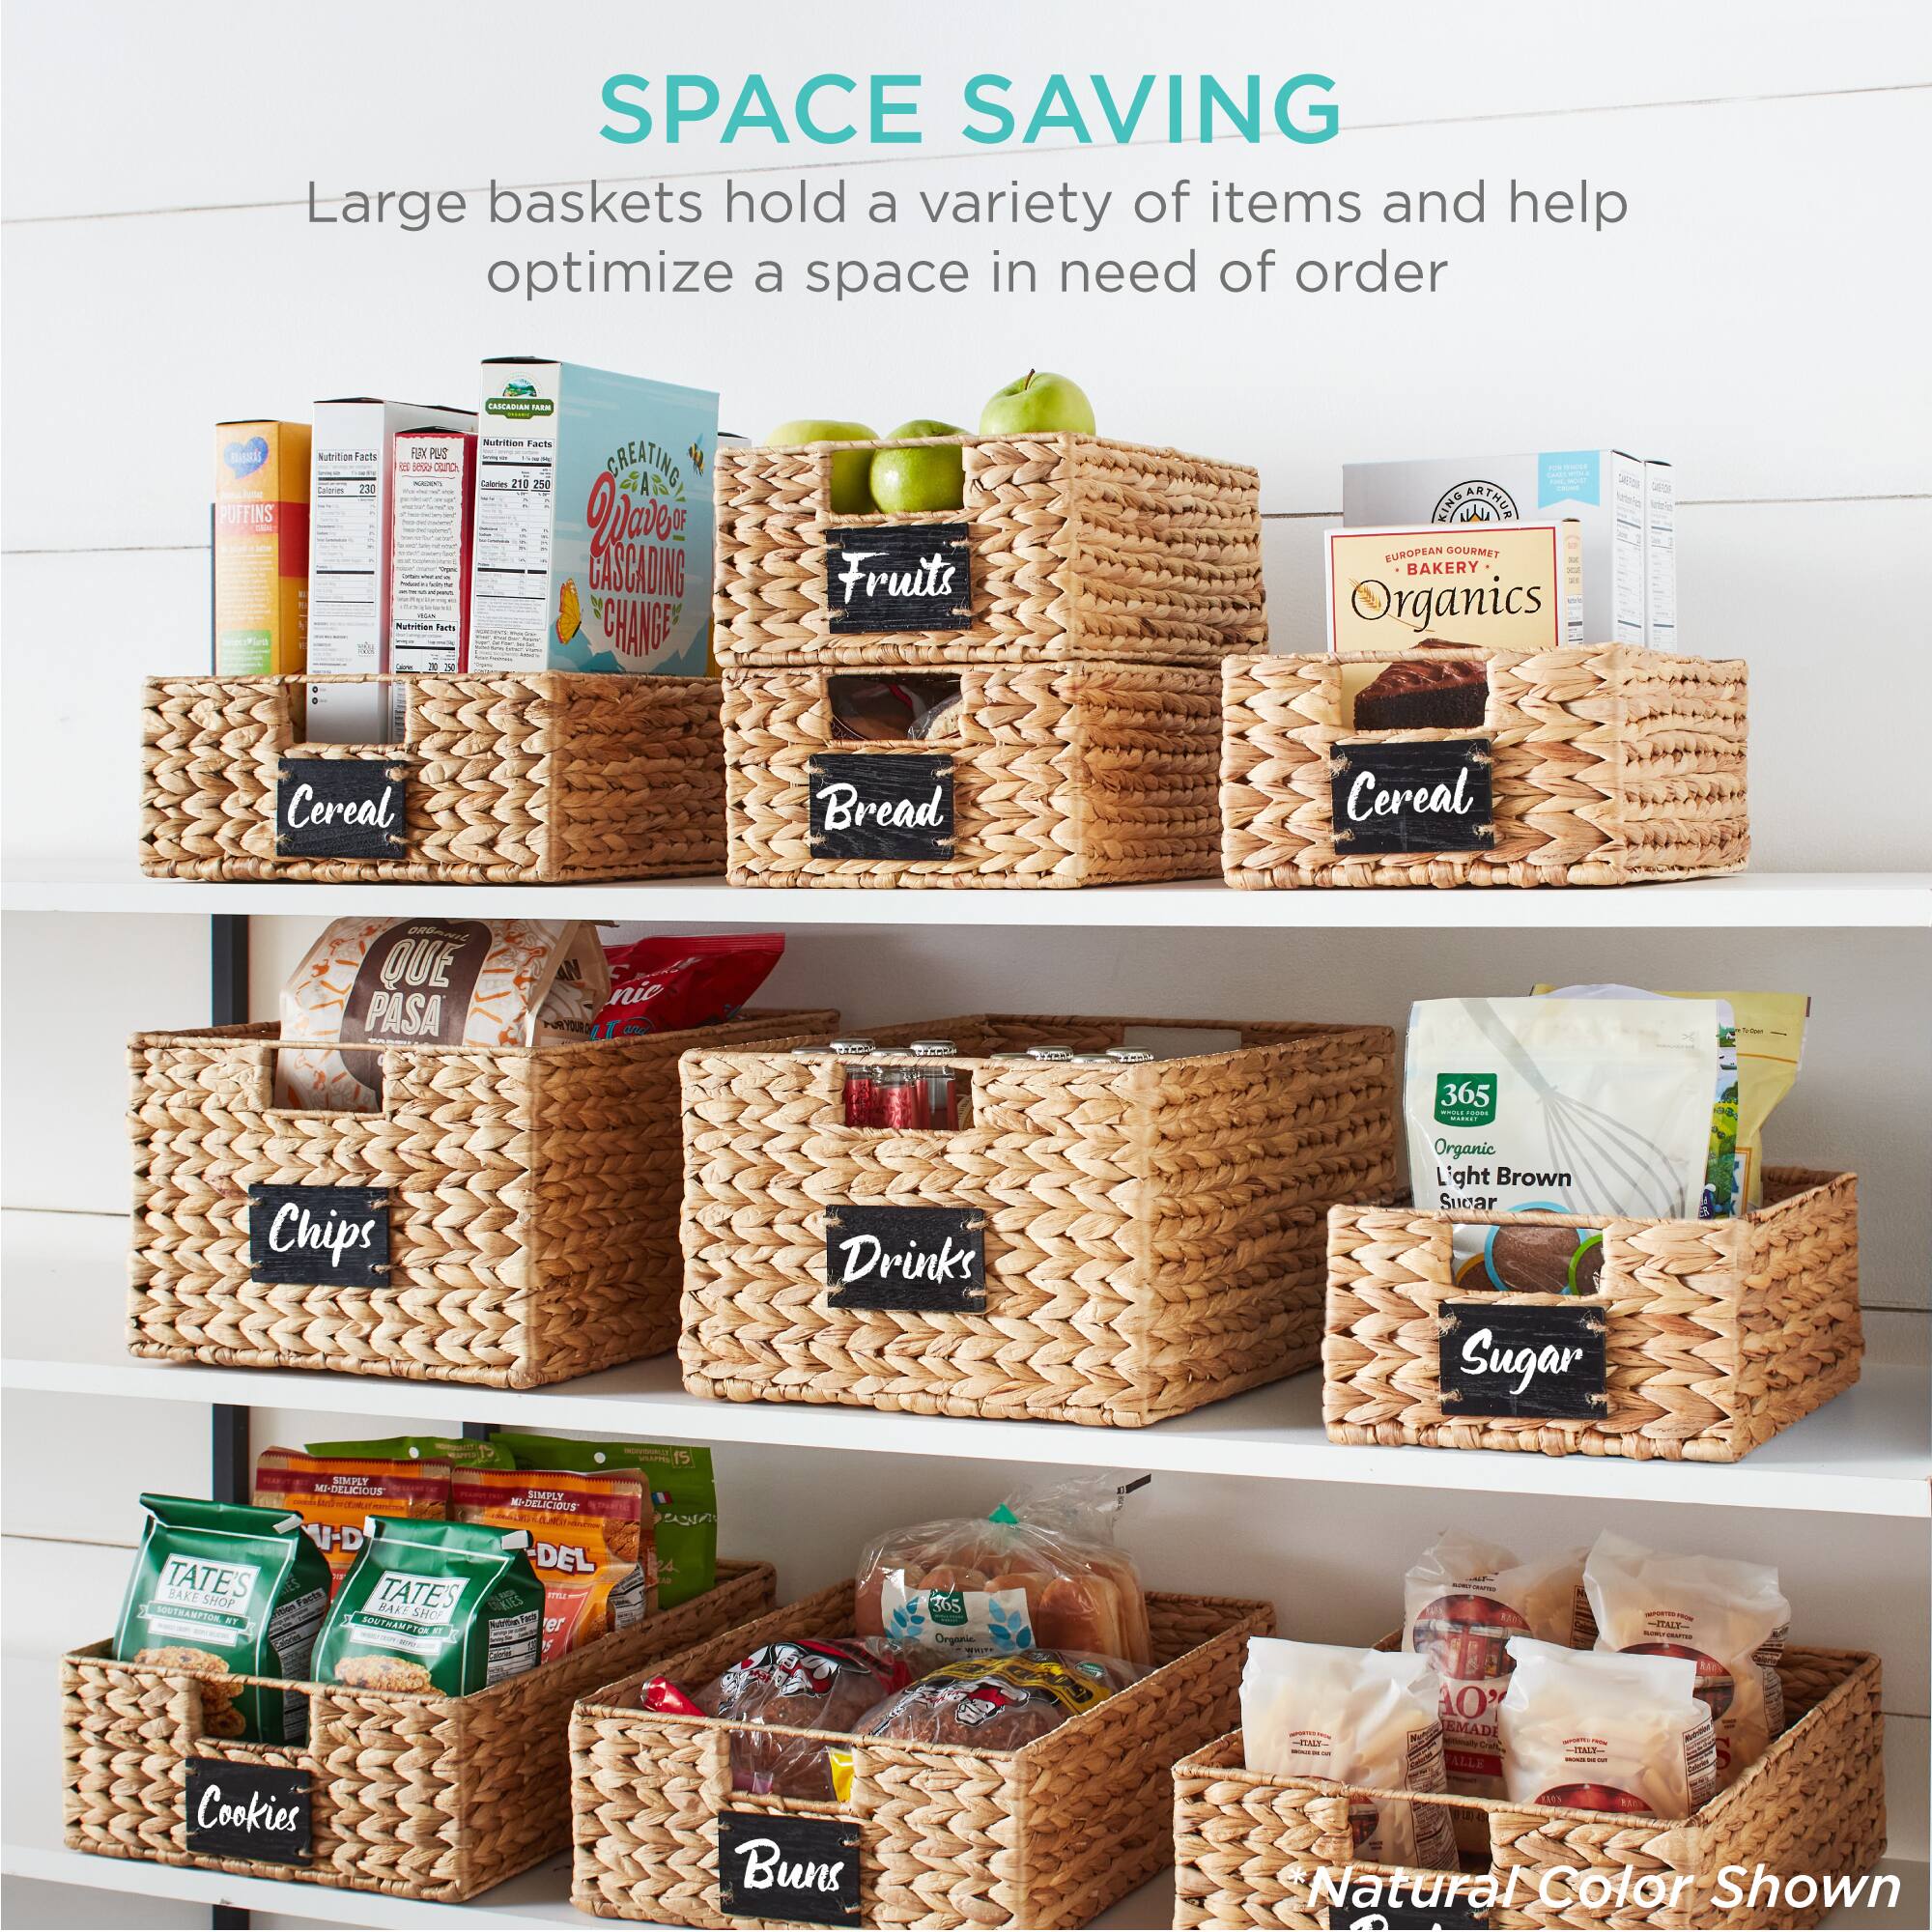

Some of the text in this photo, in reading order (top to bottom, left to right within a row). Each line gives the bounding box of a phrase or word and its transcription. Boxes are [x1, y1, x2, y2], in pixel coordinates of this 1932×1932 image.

[483, 438, 553, 448] Nutrition Facts
[318, 451, 378, 462] Nutrition Facts
[430, 447, 448, 460] PLUS
[607, 440, 680, 488] CREATING
[359, 483, 376, 495] 230
[480, 478, 551, 490] Calories 210 250
[639, 470, 650, 496] A
[219, 503, 272, 524] PUFFINS
[586, 470, 688, 557] Wave OF
[1437, 486, 1513, 523] KING ARTHUR
[1385, 546, 1500, 563] EUROPEAN GOURMET
[588, 541, 686, 599] CASCADING
[1406, 560, 1479, 576] BAKERY
[838, 552, 956, 605] Fruits
[1351, 575, 1542, 633] Organics
[395, 622, 456, 632] Nutrition Facts
[603, 597, 672, 658] CHANGE
[444, 663, 456, 672] 250
[1347, 766, 1474, 822] Cereal
[287, 779, 395, 829] Cereal
[816, 782, 944, 831] Bread
[407, 925, 470, 942] ORGANIC
[380, 938, 467, 991] QUE
[364, 990, 441, 1037] PASA
[565, 1019, 587, 1035] YOUR
[1440, 1081, 1491, 1108] 365
[1435, 1137, 1496, 1159] Organic
[1436, 1165, 1572, 1189] Light Brown
[269, 1202, 376, 1267] Chips
[838, 1234, 976, 1284] Drinks
[1460, 1327, 1583, 1395] Sugar
[624, 1447, 669, 1457] INDIVIDUALLY
[332, 1476, 369, 1486] SIMPLY
[527, 1490, 564, 1500] SIMPLY
[525, 1542, 595, 1573] -DEL
[166, 1560, 251, 1598] TATE'S
[168, 1589, 236, 1608] BAKE SHOP
[298, 1590, 323, 1606] Facts
[380, 1577, 460, 1608] TATE'S
[547, 1591, 567, 1600] STYLE
[378, 1602, 410, 1615] BAKE
[932, 1596, 961, 1614] 365
[225, 1616, 239, 1625] NY
[490, 1612, 537, 1630] Nutrition Facts
[1676, 1612, 1694, 1623] FROM
[273, 1633, 301, 1650] Calories
[935, 1633, 976, 1646] Organic
[489, 1650, 512, 1661] Calories
[1685, 1723, 1711, 1744] Nutrition
[1409, 1751, 1434, 1768] Calories
[1687, 1759, 1710, 1774] Calories
[197, 1784, 299, 1833] Cookies
[734, 1838, 844, 1892] Buns
